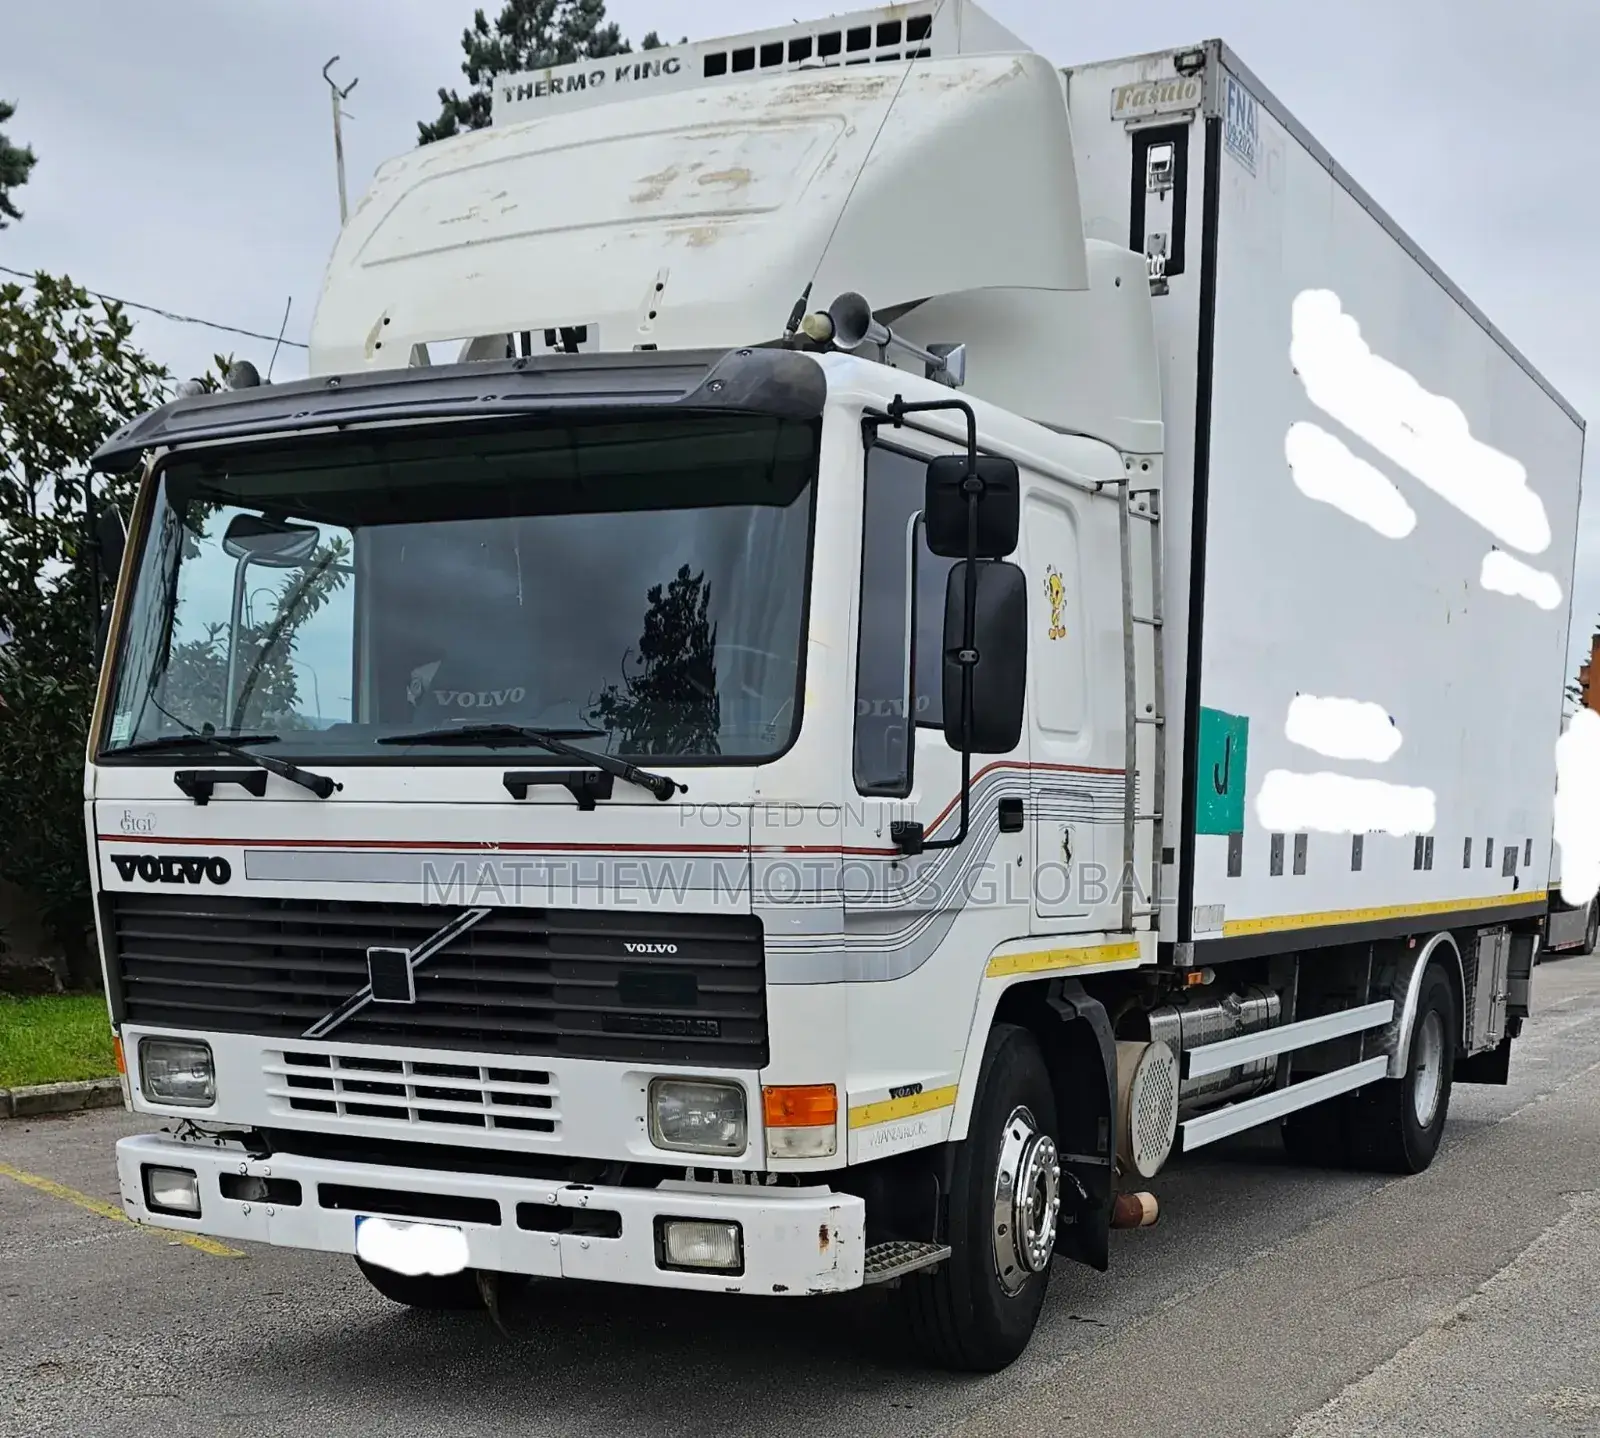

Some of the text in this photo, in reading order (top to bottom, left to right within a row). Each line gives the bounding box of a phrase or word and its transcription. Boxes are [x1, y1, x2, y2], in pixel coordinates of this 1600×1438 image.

[503, 57, 681, 102] THERMO KING
[1228, 79, 1255, 139] FNA
[432, 686, 526, 708] VOLVO
[110, 854, 232, 885] VOLVO
[624, 943, 678, 954] VOLVO
